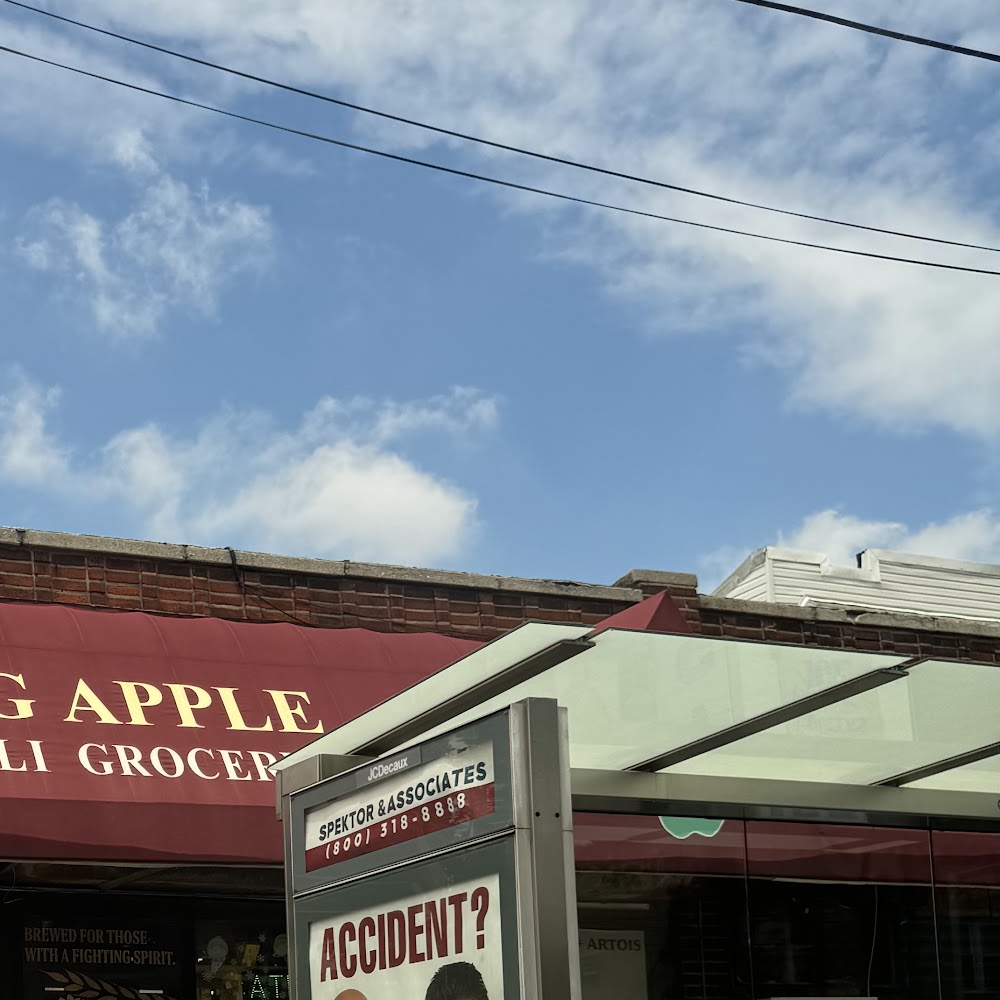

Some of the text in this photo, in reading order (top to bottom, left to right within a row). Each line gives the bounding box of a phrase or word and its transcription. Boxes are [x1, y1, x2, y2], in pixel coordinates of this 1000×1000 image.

[63, 677, 325, 735] APPLE
[79, 742, 291, 783] GROCER
[367, 755, 408, 782] JCDecaux
[318, 761, 487, 842] SPEKTOR & ASSOCIATES
[325, 792, 467, 860] (800) 318-8888
[24, 927, 148, 945] BREWED FOR THOSE
[320, 886, 490, 983] ACCIDENT?
[587, 937, 641, 951] ARTOIS
[24, 947, 176, 966] WITH A FIGHTING SPIRIT.
[250, 974, 289, 999] AT
